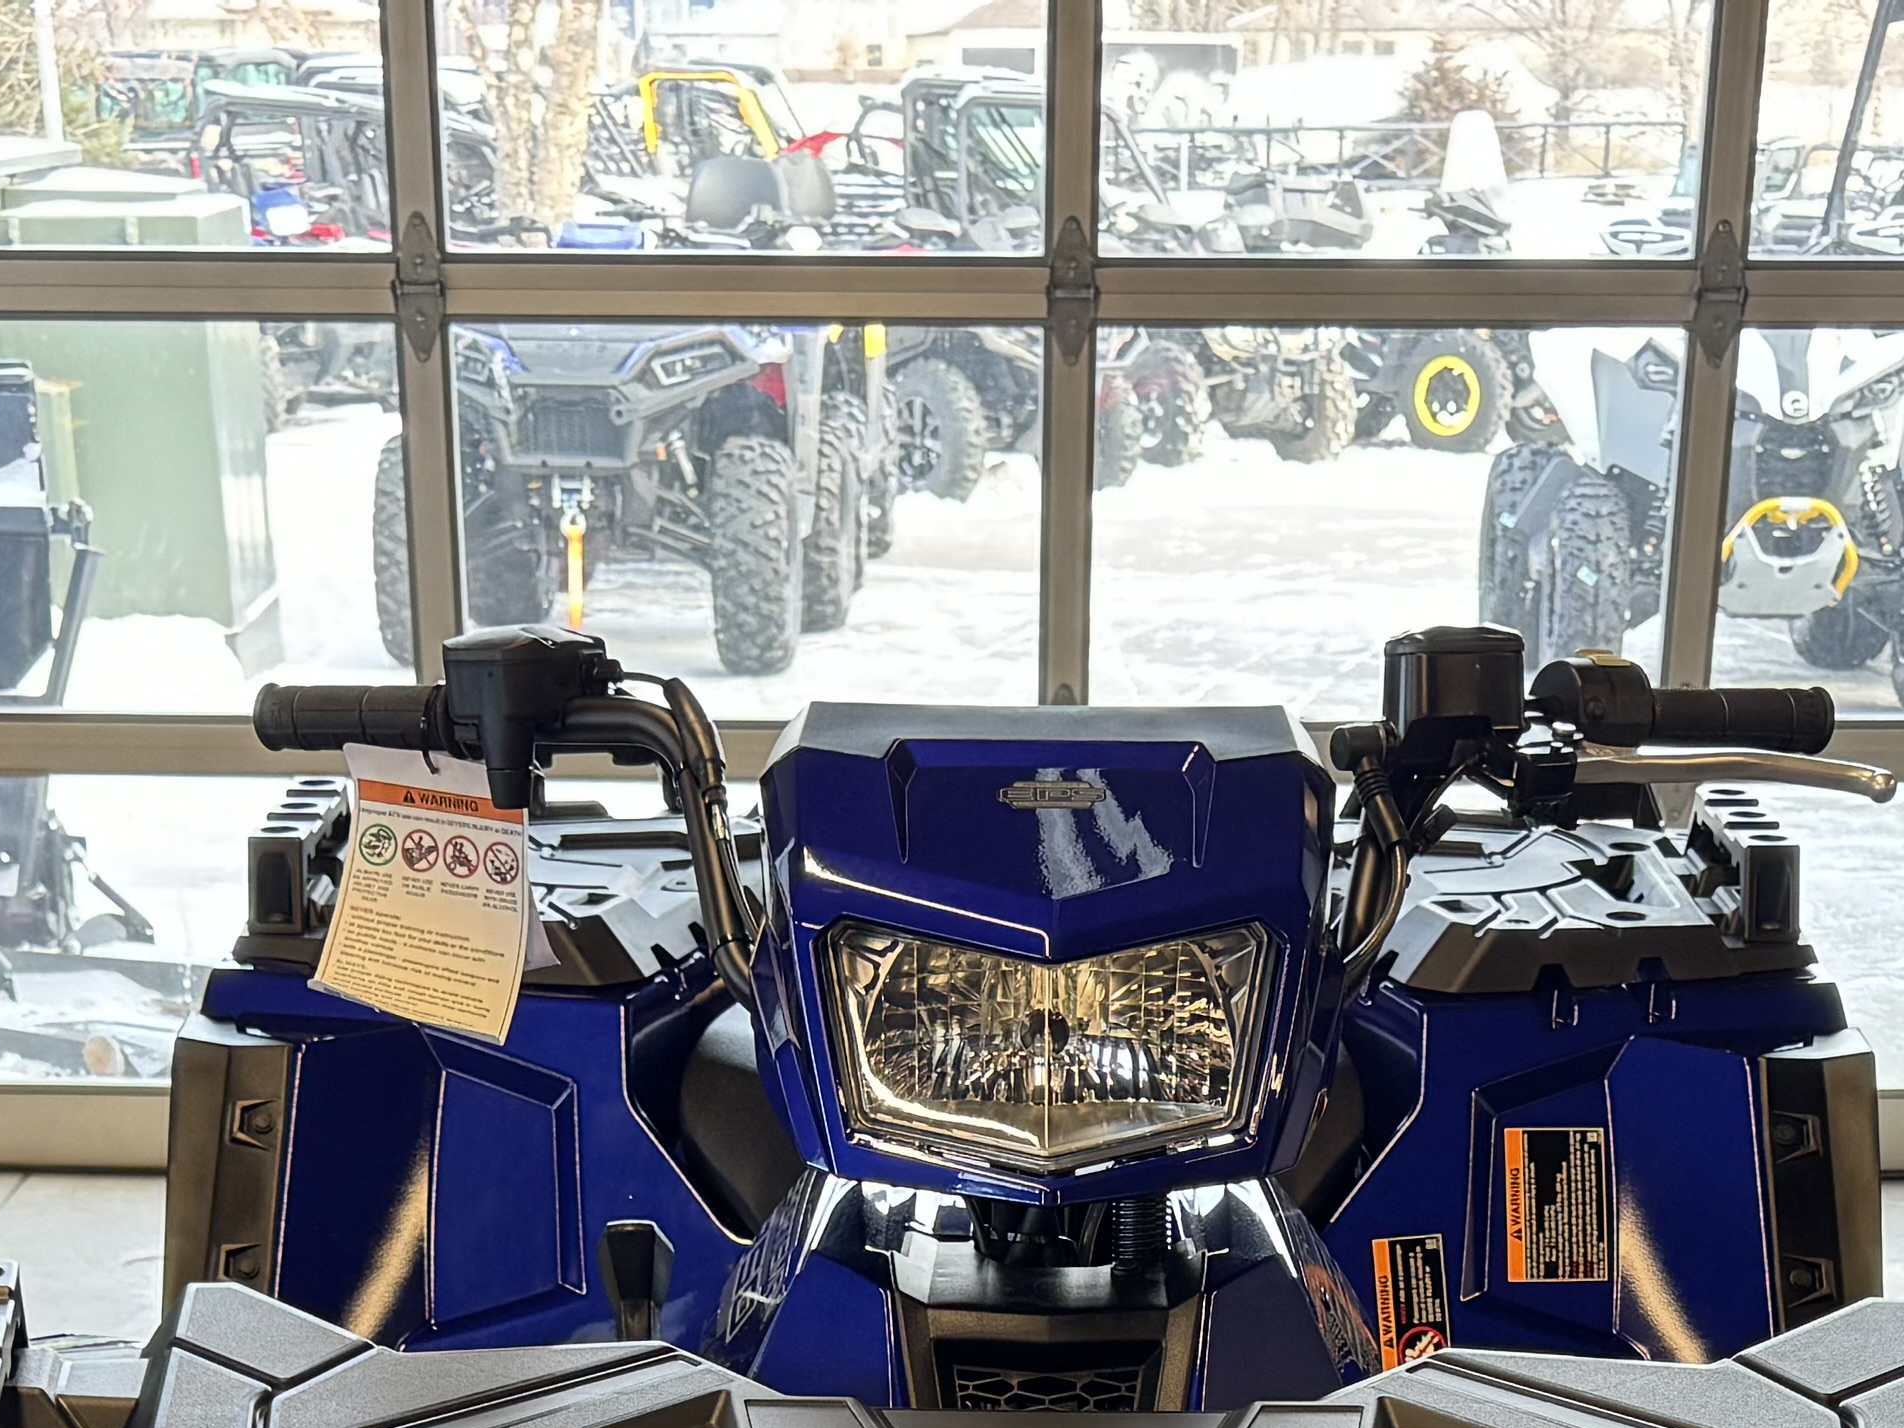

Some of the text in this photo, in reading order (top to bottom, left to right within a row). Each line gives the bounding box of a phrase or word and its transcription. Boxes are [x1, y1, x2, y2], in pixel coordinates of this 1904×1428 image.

[417, 792, 479, 812] WARNING
[1509, 1167, 1522, 1228] WARNING
[1377, 1275, 1394, 1336] WARNING
